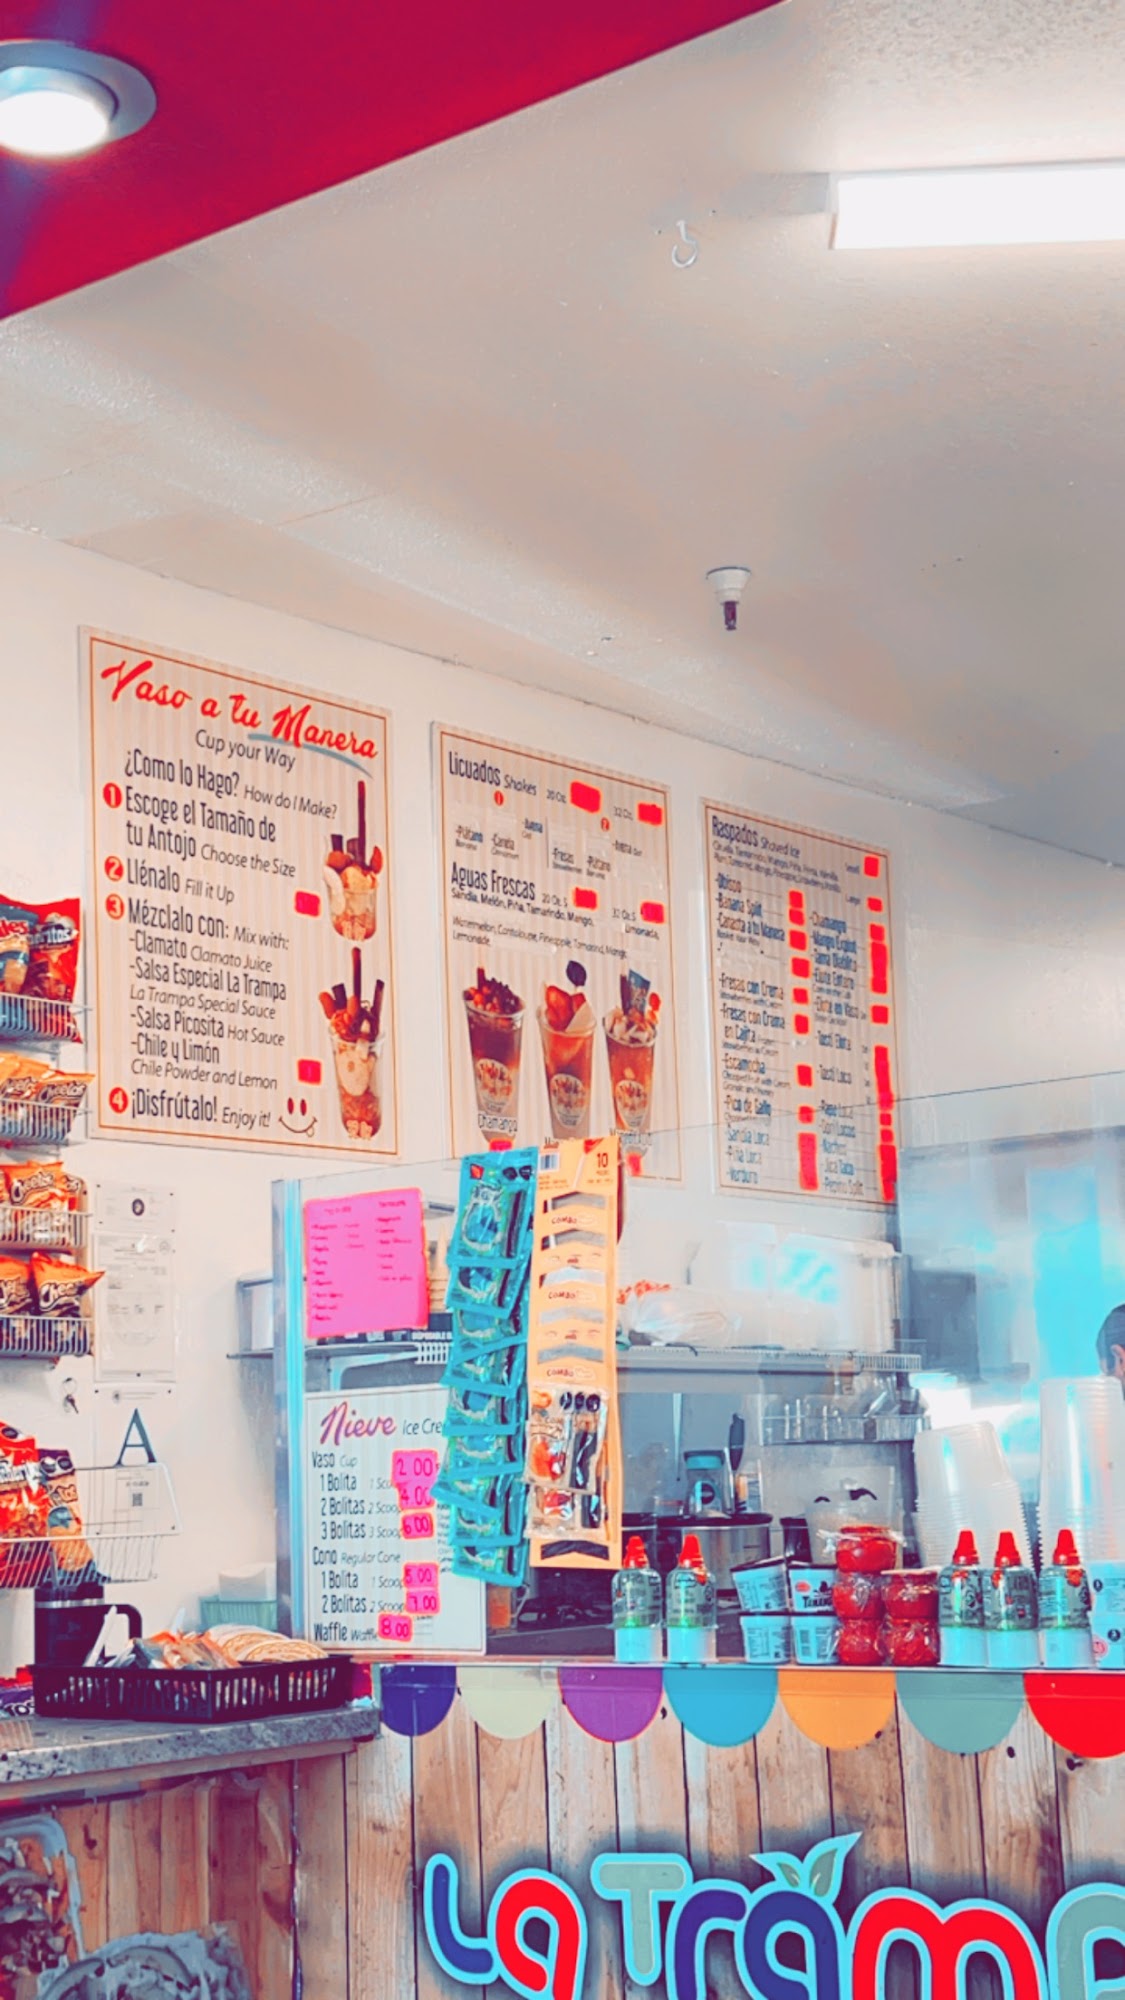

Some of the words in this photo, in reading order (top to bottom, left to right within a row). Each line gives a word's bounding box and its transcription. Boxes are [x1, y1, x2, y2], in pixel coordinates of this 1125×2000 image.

[101, 660, 192, 709] Vaso
[201, 698, 221, 718] a
[229, 694, 261, 728] tu
[272, 704, 378, 758] Manera
[195, 729, 225, 752] Cup
[228, 740, 260, 762] your
[265, 746, 295, 773] Way
[124, 749, 174, 782] ¿Como
[180, 759, 192, 785] lo
[197, 765, 239, 799] Hago?
[244, 785, 272, 804] How
[275, 791, 290, 808] do
[299, 796, 336, 819] Make?
[449, 752, 500, 786] Licuados
[504, 774, 536, 796] Shakes
[126, 786, 178, 823] Escoge
[184, 798, 195, 825] el
[201, 803, 254, 838] Tamaño
[259, 816, 276, 842] de
[712, 815, 758, 847] Raspados
[127, 821, 142, 846] tu
[148, 825, 196, 861] Antojo
[201, 844, 247, 867] Choose
[251, 852, 271, 872] the
[273, 856, 296, 877] Size
[127, 857, 180, 893] Llénalo
[185, 879, 202, 897] Fill
[205, 883, 213, 899] it
[216, 884, 235, 904] Up
[451, 862, 487, 890] Aguas
[491, 869, 535, 900] Frescas
[128, 898, 193, 933] Mézclalo
[199, 913, 229, 939] con:
[234, 926, 258, 945] Mix
[259, 931, 289, 950] with:
[191, 945, 240, 968] Clamato
[244, 955, 272, 972] Juice
[173, 963, 223, 994] Especial
[227, 973, 240, 993] La
[244, 975, 286, 1001] Trampa
[130, 985, 144, 1001] La
[148, 986, 195, 1010] Trampa
[198, 994, 239, 1016] Special
[243, 1001, 275, 1019] Sauce
[175, 1011, 224, 1038] Picosita
[228, 1025, 248, 1041] Hot
[251, 1028, 284, 1046] Sauce
[172, 1040, 179, 1062] y
[183, 1038, 219, 1064] Limón
[132, 1059, 161, 1077] Chile
[165, 1061, 208, 1082] Powder
[212, 1068, 235, 1085] and
[239, 1069, 277, 1090] Lemon
[132, 1087, 217, 1122] ¡Disfrútalo!
[222, 1107, 256, 1130] Enjoy
[259, 1112, 270, 1127] it!
[597, 1152, 608, 1168] 10
[114, 1408, 156, 1467] A
[320, 1401, 397, 1446] Nieve
[403, 1420, 420, 1435] Ice
[421, 1417, 441, 1435] Cre
[312, 1451, 335, 1468] Vaso
[340, 1454, 358, 1467] Cup
[321, 1474, 324, 1491] 1
[328, 1472, 356, 1491] Bolita
[321, 1498, 327, 1516] 2
[330, 1497, 365, 1515] Bolitas
[368, 1502, 373, 1514] 2
[322, 1521, 327, 1540] 3
[330, 1520, 366, 1540] Bolitas
[313, 1546, 337, 1565] Cono
[341, 1552, 375, 1567] Regular
[377, 1551, 400, 1563] Cone
[322, 1571, 326, 1588] 1
[329, 1570, 358, 1589] Bolita
[322, 1594, 328, 1613] 2
[331, 1594, 366, 1613] Bolitas
[370, 1601, 375, 1612] 2
[314, 1622, 347, 1641] Waffle
[424, 1852, 588, 2000] La
